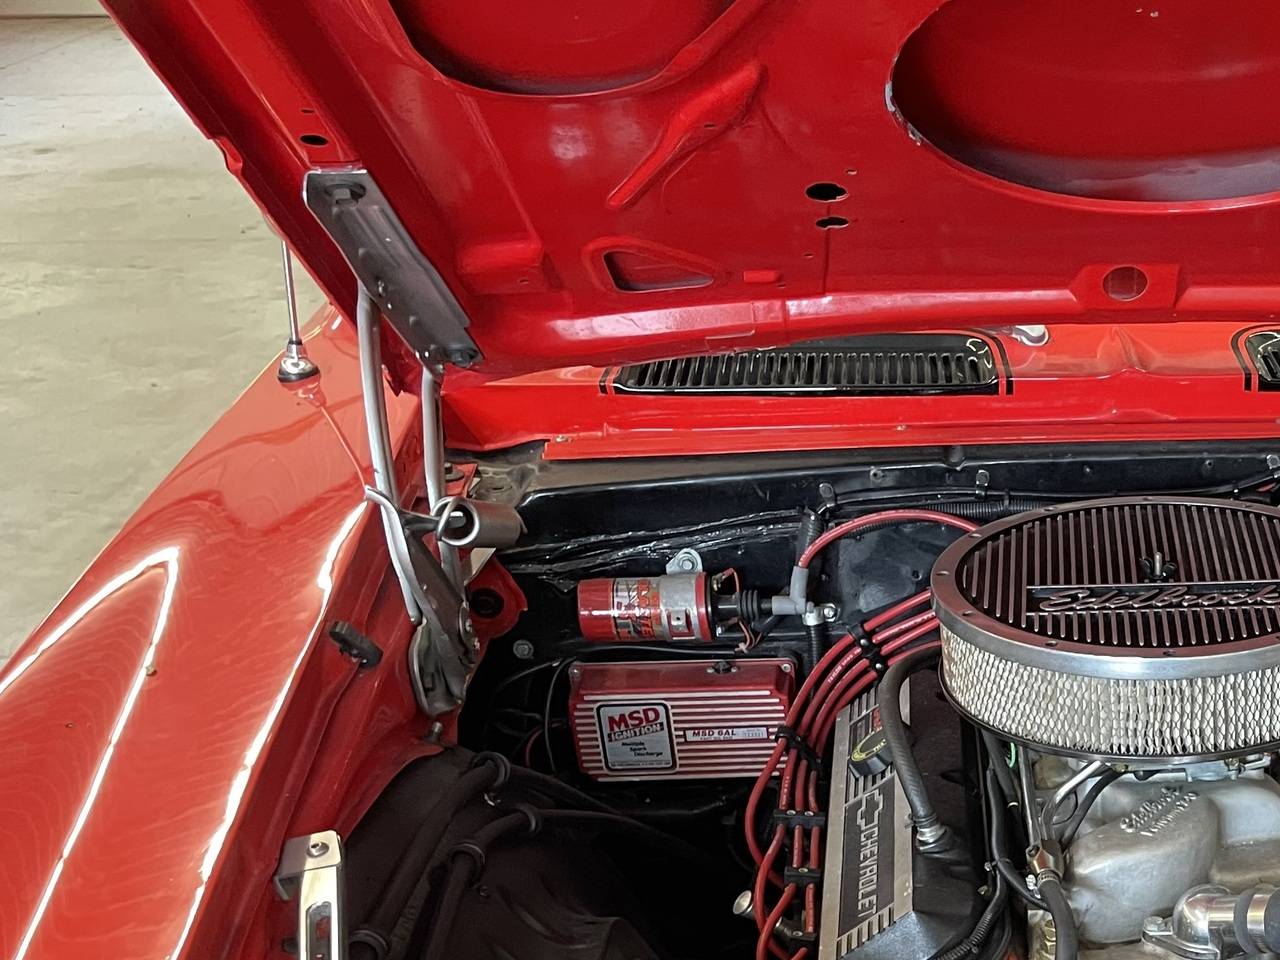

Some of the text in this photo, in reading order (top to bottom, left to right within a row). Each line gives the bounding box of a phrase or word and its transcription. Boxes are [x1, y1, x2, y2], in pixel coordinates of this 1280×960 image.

[608, 707, 660, 732] MSD
[611, 723, 661, 741] IGNITION
[692, 729, 715, 738] MSD
[857, 826, 880, 918] CHEVROLET
